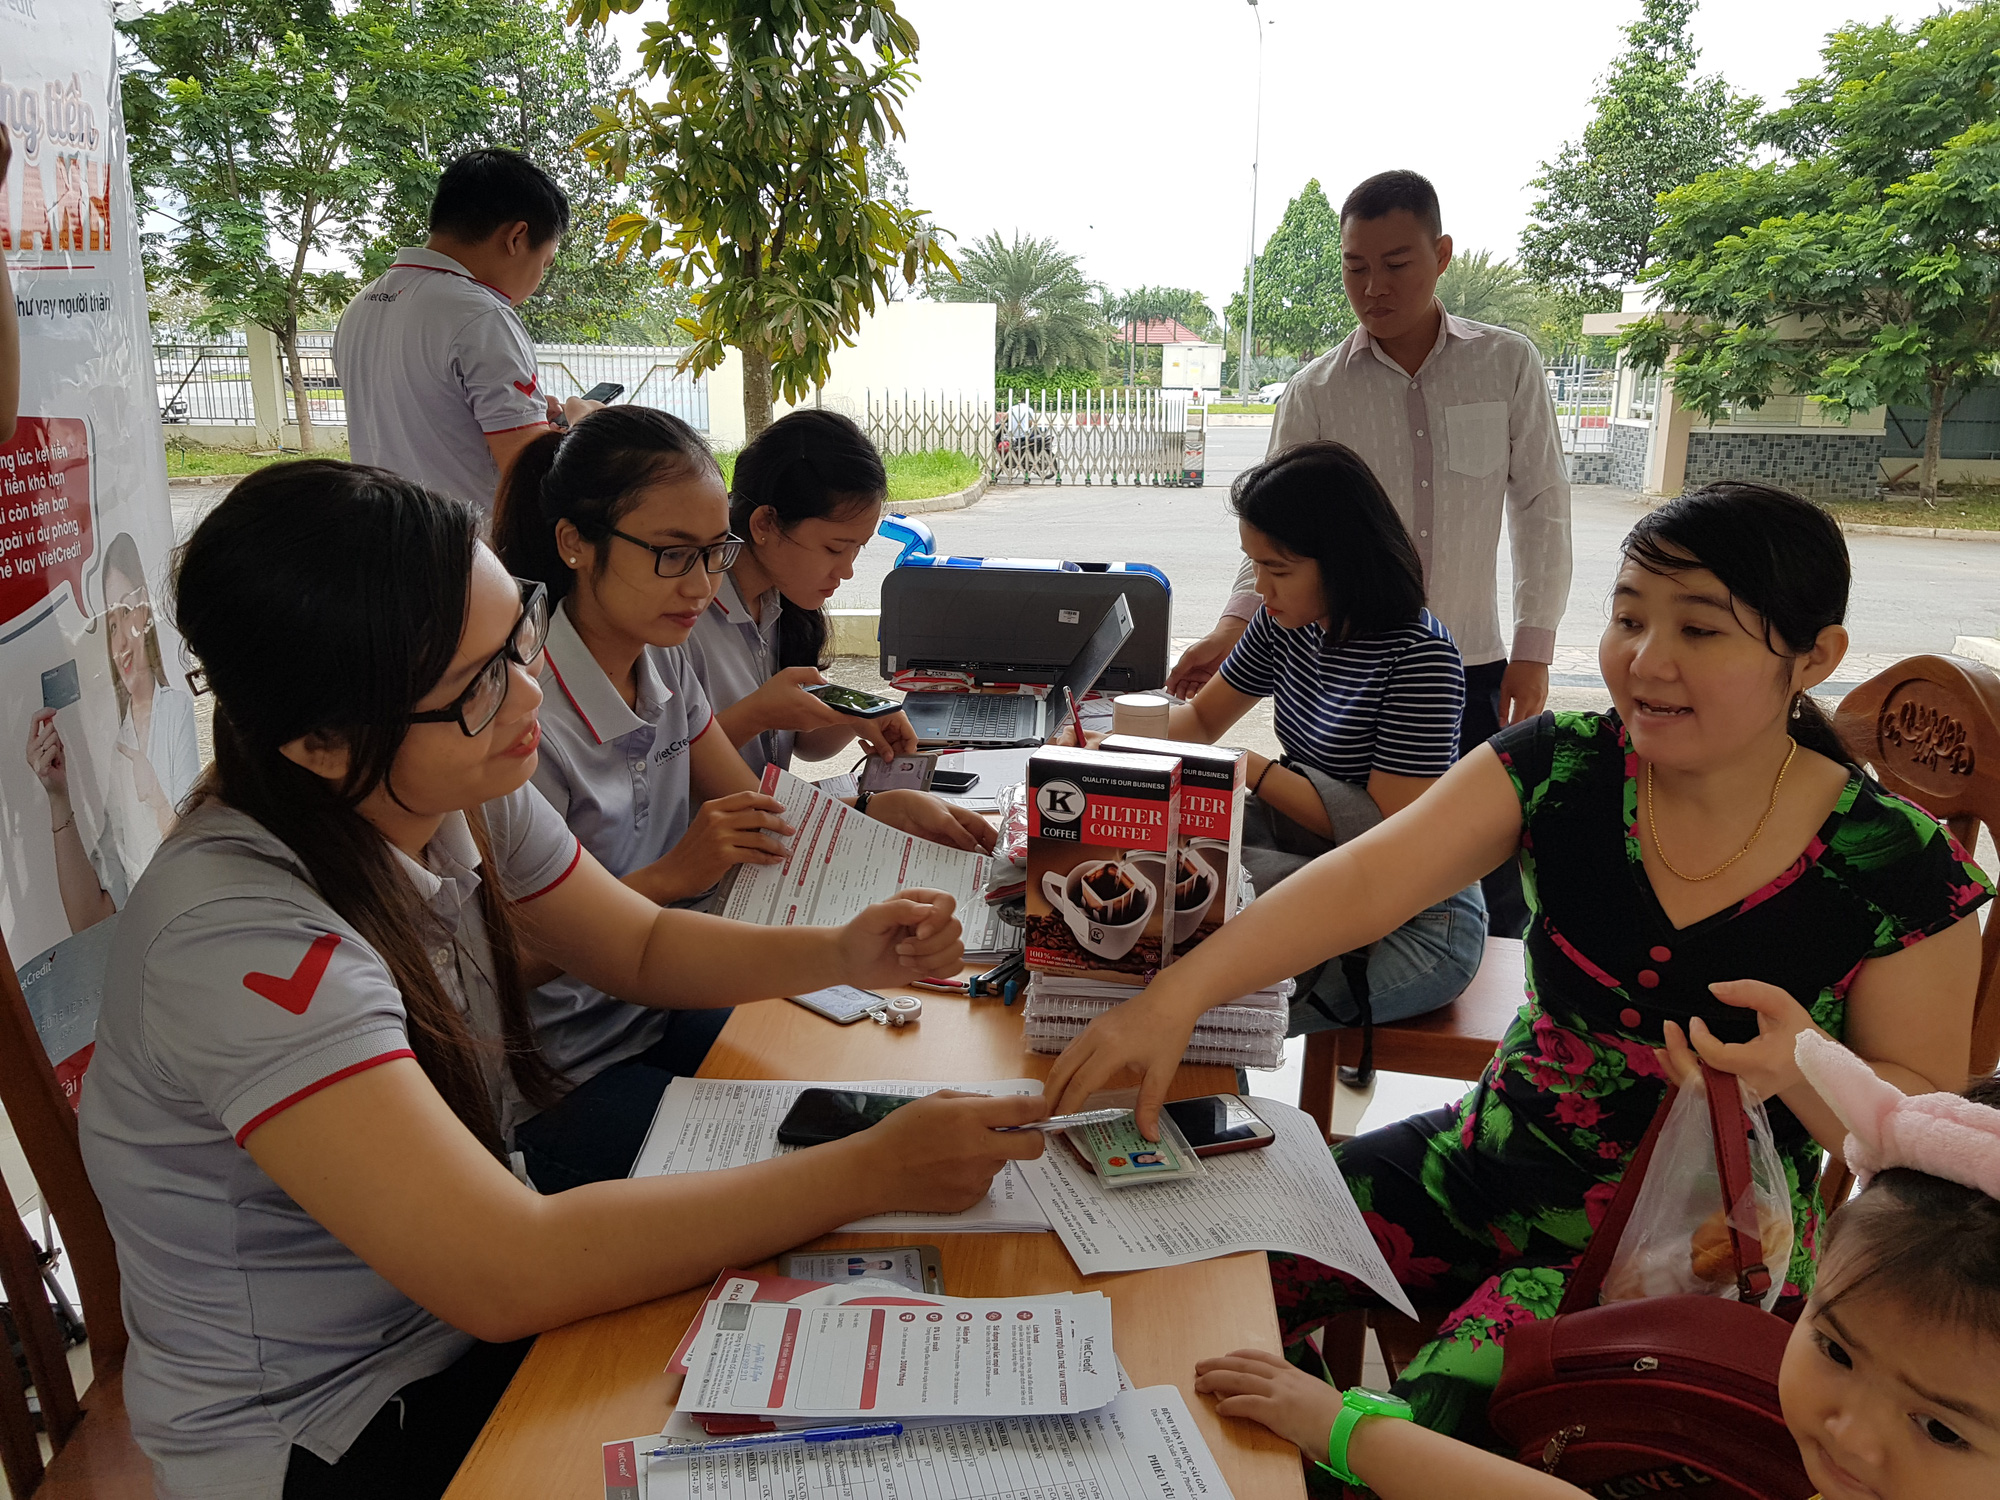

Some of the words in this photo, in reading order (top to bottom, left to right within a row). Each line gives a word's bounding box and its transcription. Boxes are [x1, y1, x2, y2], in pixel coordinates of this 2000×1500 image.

[15, 294, 34, 316] hư
[36, 298, 56, 320] vay
[59, 293, 88, 319] người
[90, 294, 111, 313] thân
[16, 447, 33, 467] lúc
[35, 445, 50, 467] kẹt
[51, 439, 68, 460] tiền
[4, 473, 26, 496] tiền
[27, 472, 47, 492] khô
[48, 471, 65, 491] hạn
[8, 503, 30, 522] còn
[31, 498, 51, 518] bên
[52, 496, 69, 515] bạn
[25, 526, 36, 546] ví
[37, 525, 51, 545] dự
[51, 518, 79, 542] phòng
[14, 556, 37, 575] Vay
[38, 540, 82, 569] VietCredit
[654, 737, 690, 763] VietCre
[1082, 776, 1109, 785] QUALITY
[1133, 781, 1165, 790] BUSINESS
[1183, 768, 1197, 776] OUR
[1198, 770, 1229, 779] BUSINESS
[1046, 788, 1076, 815] K
[1091, 804, 1163, 826] FILTER
[1043, 827, 1077, 840] COFFEE
[1090, 823, 1151, 841] COFFEE
[1083, 1336, 1094, 1373] VietCredit
[1058, 1370, 1066, 1379] VAY
[1059, 1380, 1068, 1406] VIETCREDIT
[720, 1459, 727, 1468] CA
[1161, 1407, 1174, 1424] BỆNH
[1169, 1424, 1182, 1440] VIỆN
[1179, 1446, 1194, 1466] DƯỢC
[1189, 1466, 1201, 1478] SÀI
[1196, 1478, 1208, 1494] GÒN
[691, 1462, 698, 1471] CA
[705, 1461, 712, 1469] CA
[1147, 1454, 1167, 1480] PHIẾU
